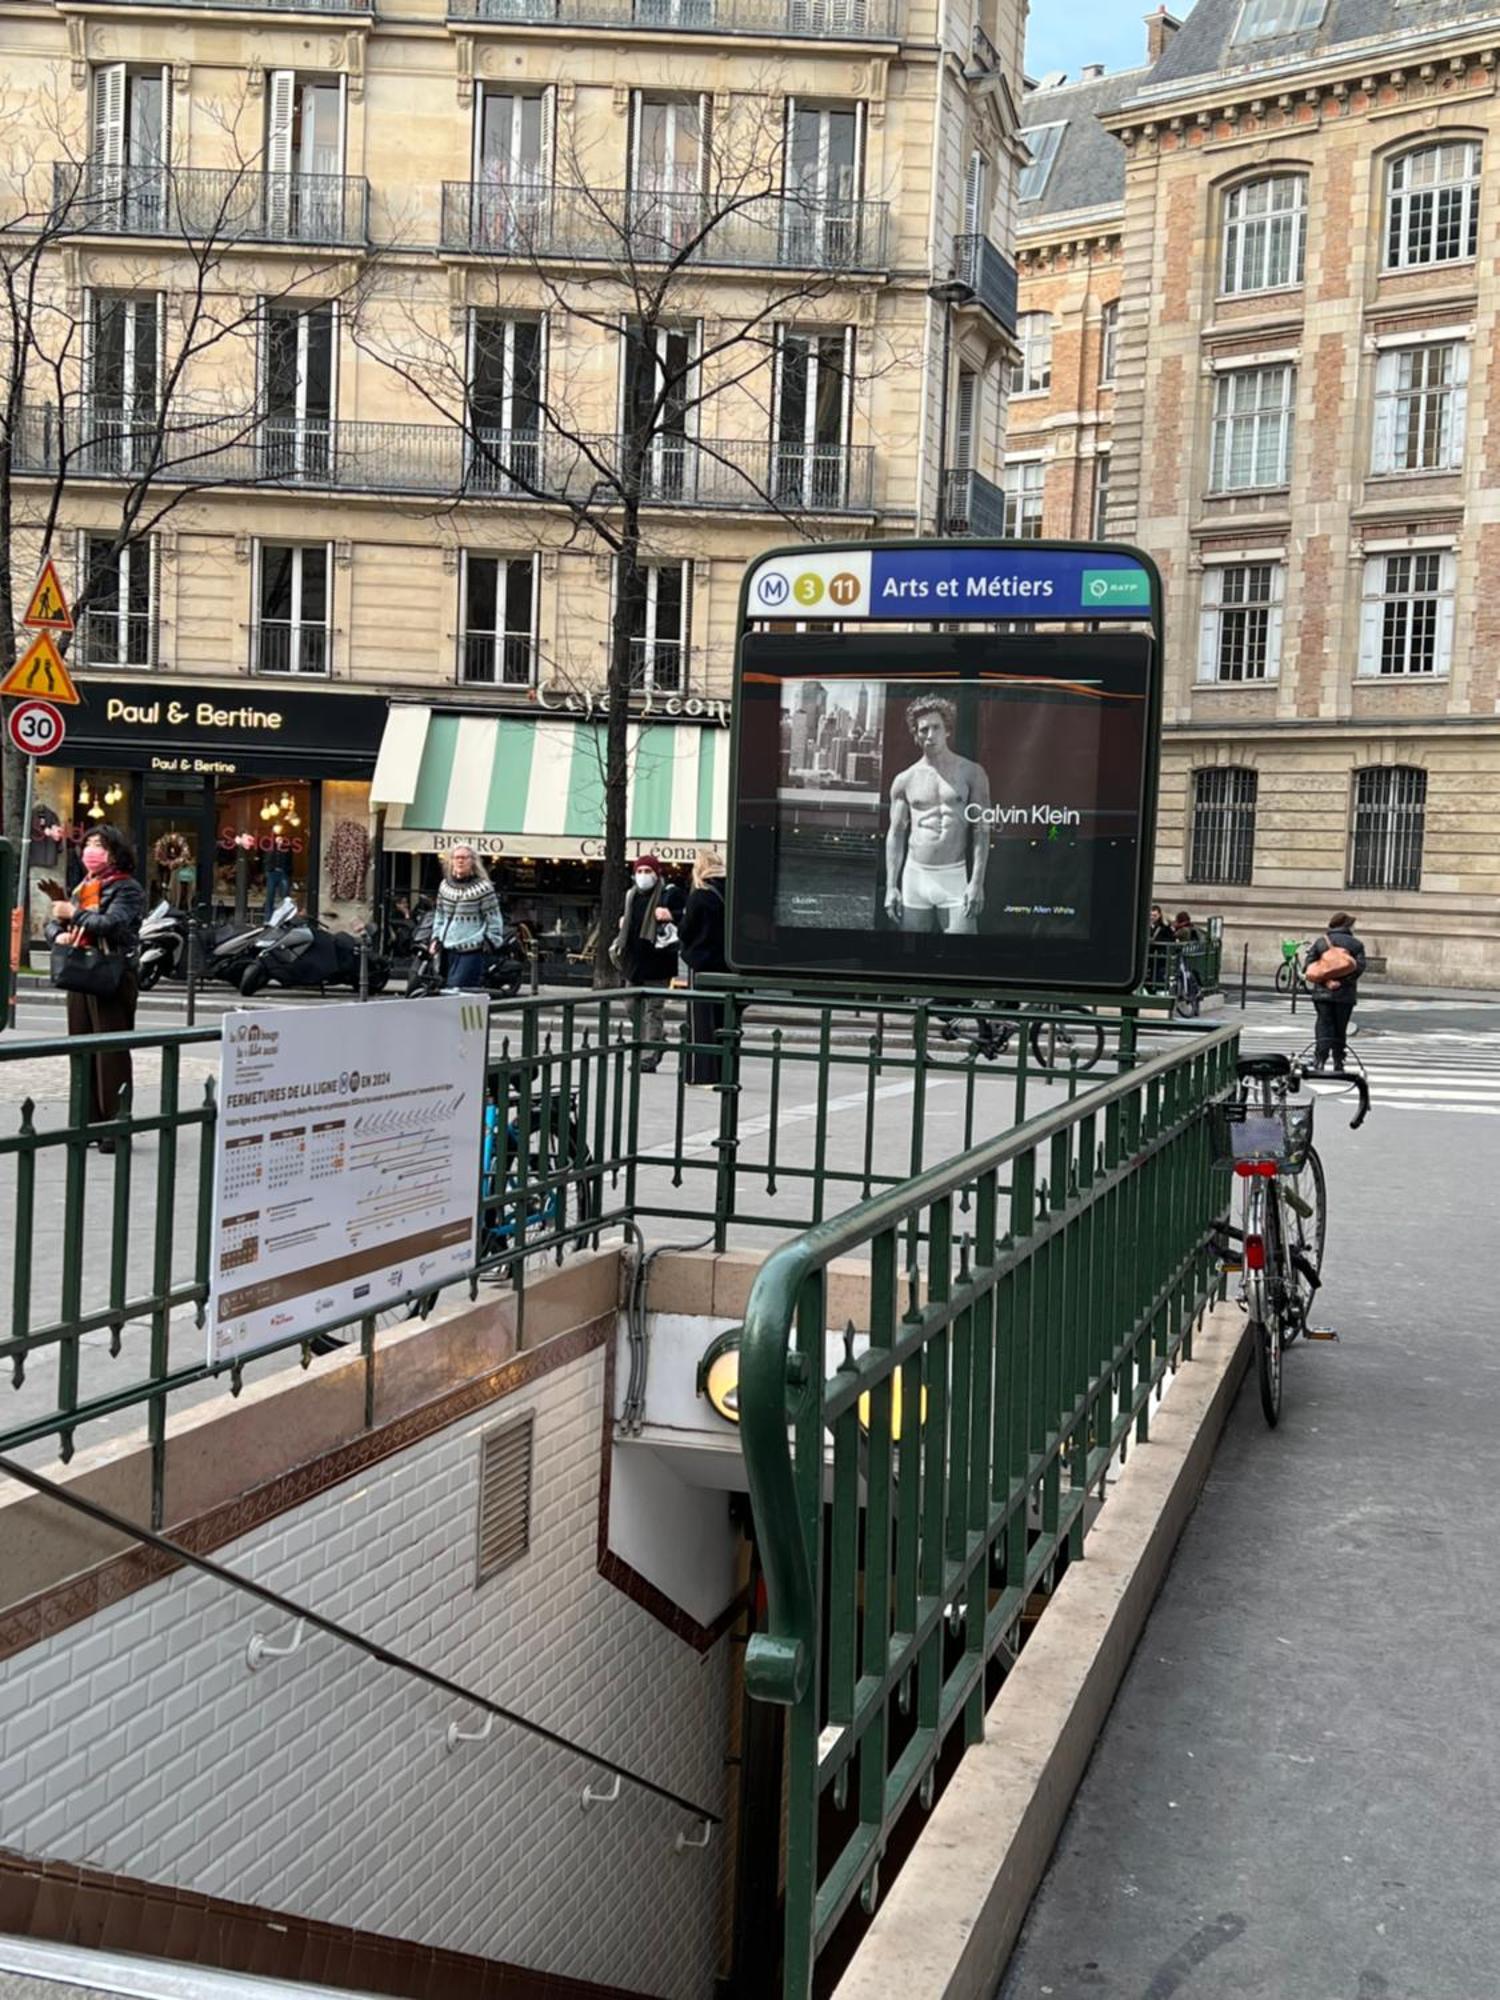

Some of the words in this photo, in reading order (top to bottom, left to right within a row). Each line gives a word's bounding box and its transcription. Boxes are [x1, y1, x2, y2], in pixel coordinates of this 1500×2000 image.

[802, 579, 816, 599] 3
[833, 580, 854, 600] 11
[882, 577, 929, 597] Arts
[936, 580, 958, 597] et
[966, 575, 1053, 597] Métiers
[107, 699, 159, 723] Paul
[166, 701, 190, 724] &
[196, 703, 283, 729] Bertine
[22, 716, 53, 739] 30
[151, 757, 178, 770] Paul
[180, 760, 191, 770] &
[194, 760, 236, 774] Bertine
[964, 803, 1027, 824] Calvin
[1031, 804, 1080, 825] Klein
[1004, 904, 1031, 914] Jeremy
[1033, 905, 1051, 914] Allen
[1053, 906, 1075, 915] White
[226, 1087, 286, 1108] FERMETURES
[287, 1085, 299, 1100] DE
[300, 1083, 312, 1098] LA
[313, 1080, 338, 1095] LIGNE
[361, 1075, 372, 1088] EN
